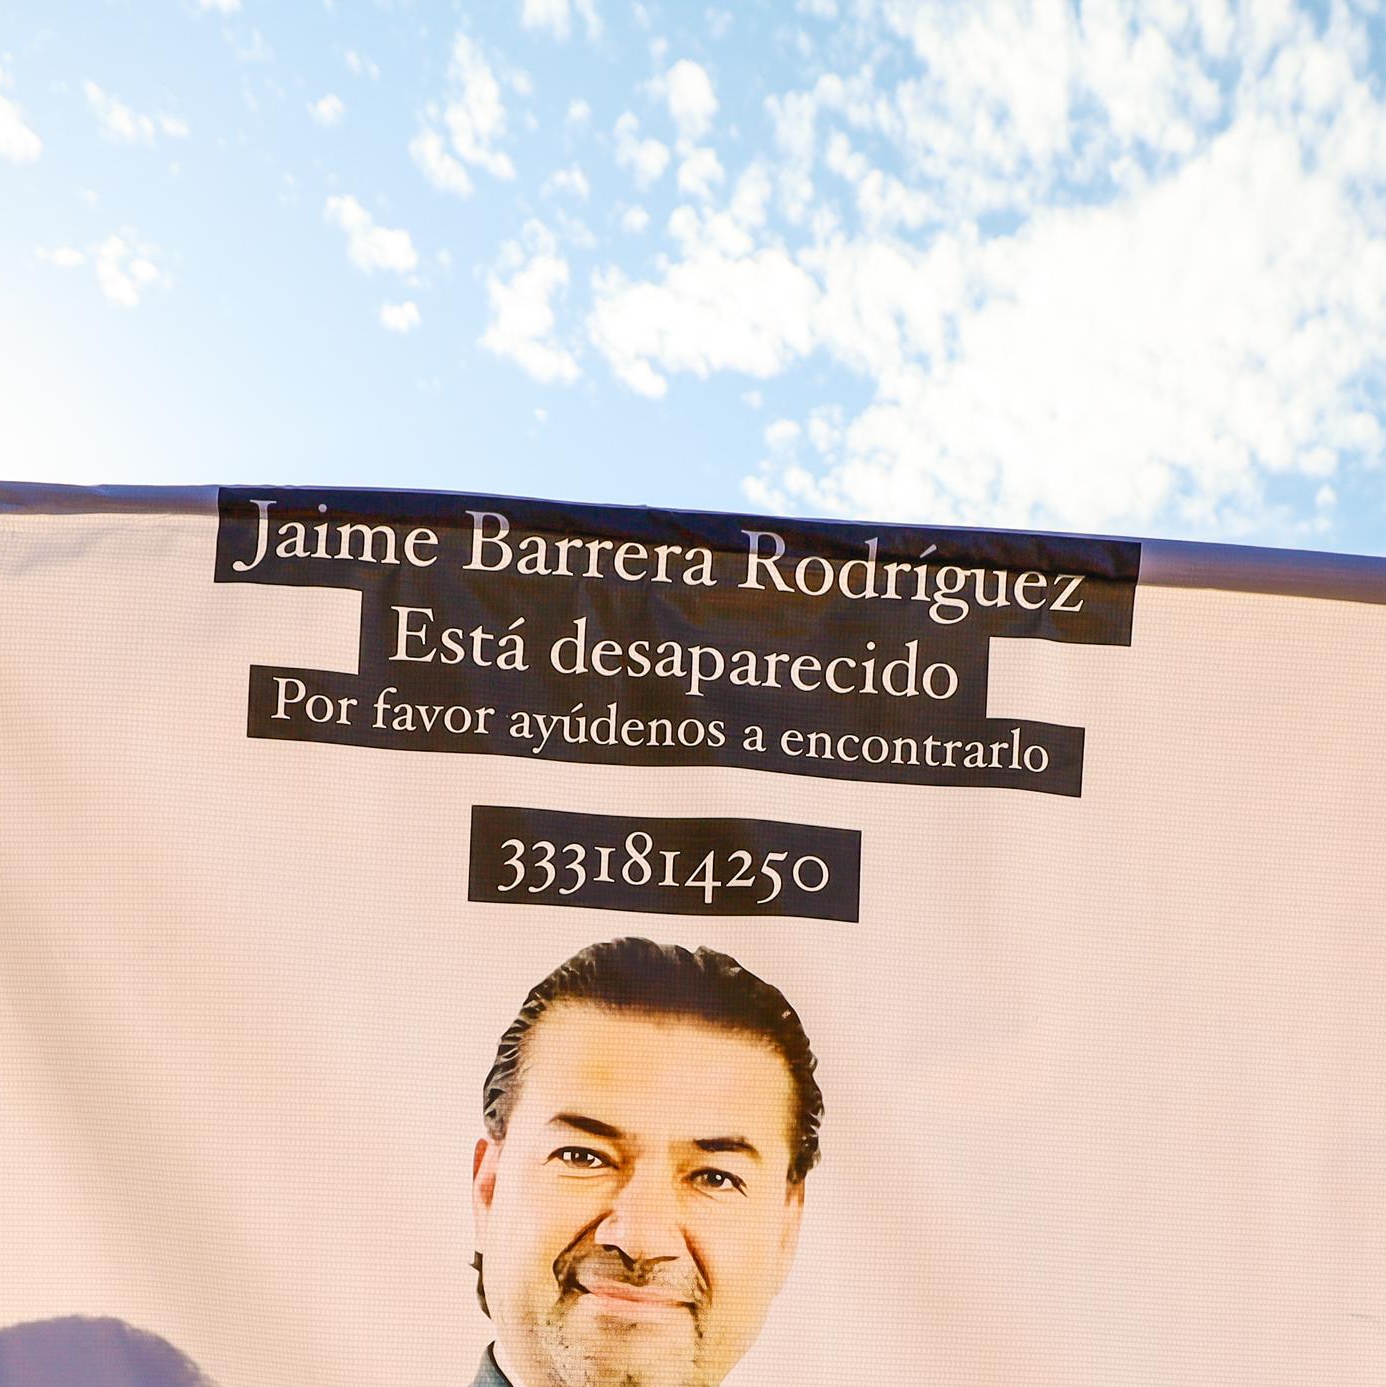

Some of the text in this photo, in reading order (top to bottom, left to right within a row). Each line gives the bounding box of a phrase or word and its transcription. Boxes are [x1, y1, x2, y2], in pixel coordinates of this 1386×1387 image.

[232, 499, 1086, 625] Jaime Barrera Rodríguez
[388, 605, 959, 700] Está desaparecido
[270, 676, 1050, 774] Por favor ayúdenos a encontrarlo
[497, 831, 830, 905] 3331814250
